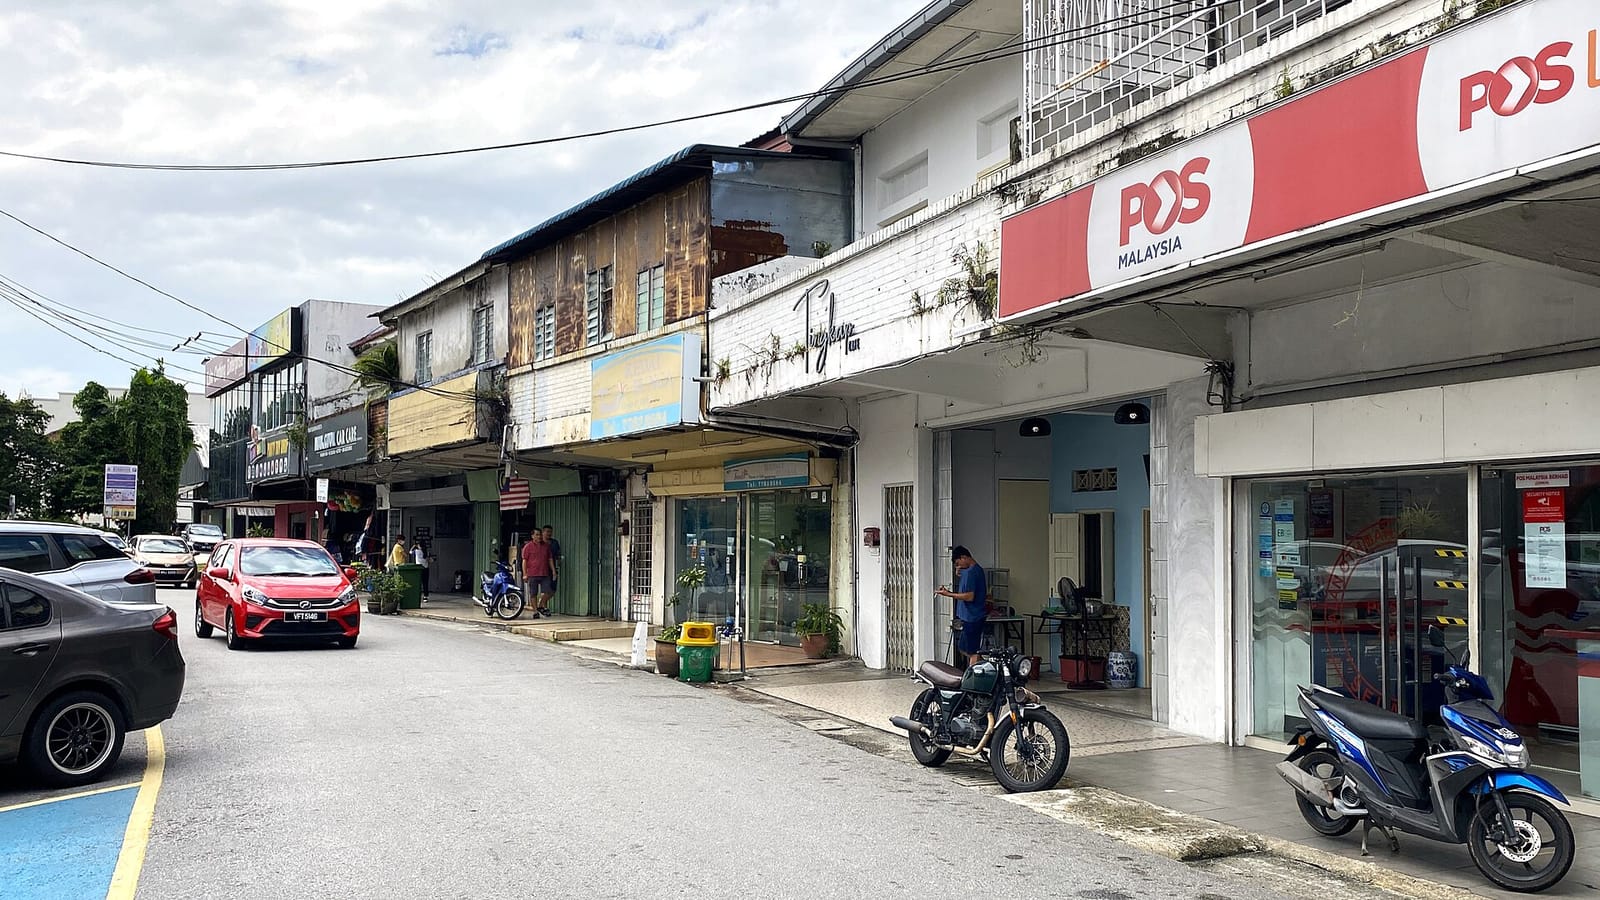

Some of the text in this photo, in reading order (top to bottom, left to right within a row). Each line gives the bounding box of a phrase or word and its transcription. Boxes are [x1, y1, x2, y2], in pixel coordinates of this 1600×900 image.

[1459, 41, 1575, 131] POS
[1119, 156, 1211, 246] POS
[1118, 235, 1182, 270] MALAYSIA
[793, 279, 855, 374] Tingkap
